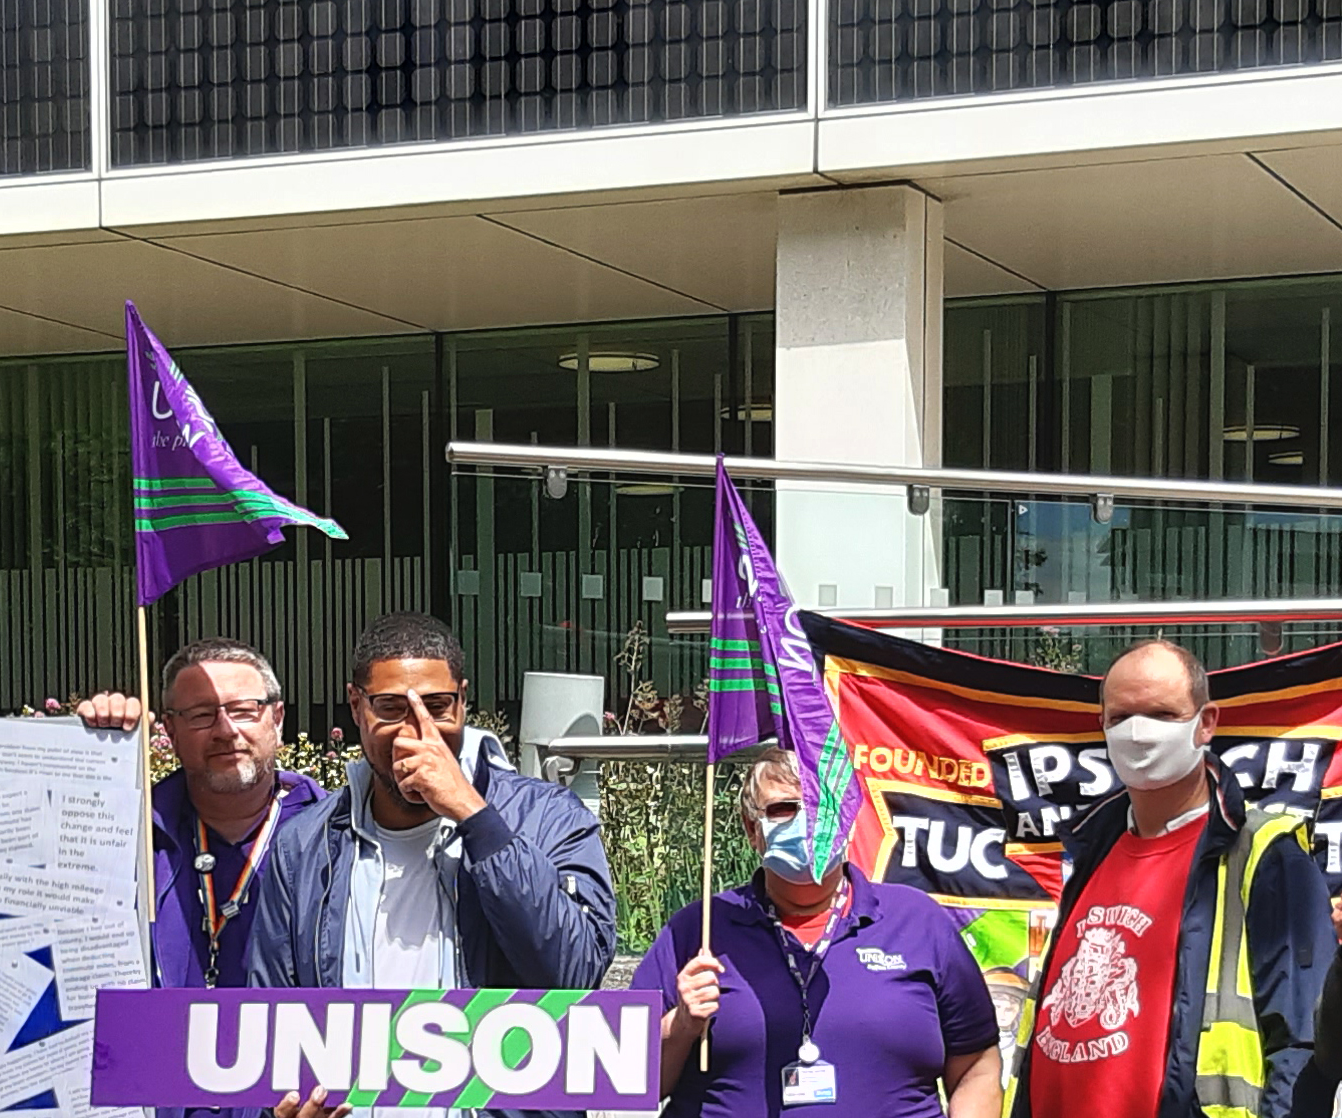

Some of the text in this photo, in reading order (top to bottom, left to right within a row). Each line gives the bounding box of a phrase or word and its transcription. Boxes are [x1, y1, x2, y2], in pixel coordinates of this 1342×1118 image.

[854, 744, 993, 788] FOUNDED
[68, 797, 105, 807] strongly
[62, 810, 114, 820] oppose this
[61, 821, 93, 832] change
[116, 826, 133, 835] feel
[60, 835, 127, 847] that it is unfair
[892, 815, 1009, 880] TUC
[15, 875, 33, 883] with
[36, 878, 49, 886] the
[52, 881, 69, 891] high
[71, 882, 104, 895] mileage
[3, 886, 15, 894] my
[18, 888, 34, 896] role
[37, 889, 42, 897] it
[45, 892, 70, 900] would
[73, 895, 95, 904] make
[5, 897, 46, 910] financially
[48, 904, 84, 914] unviable
[187, 1002, 650, 1095] UNISON
